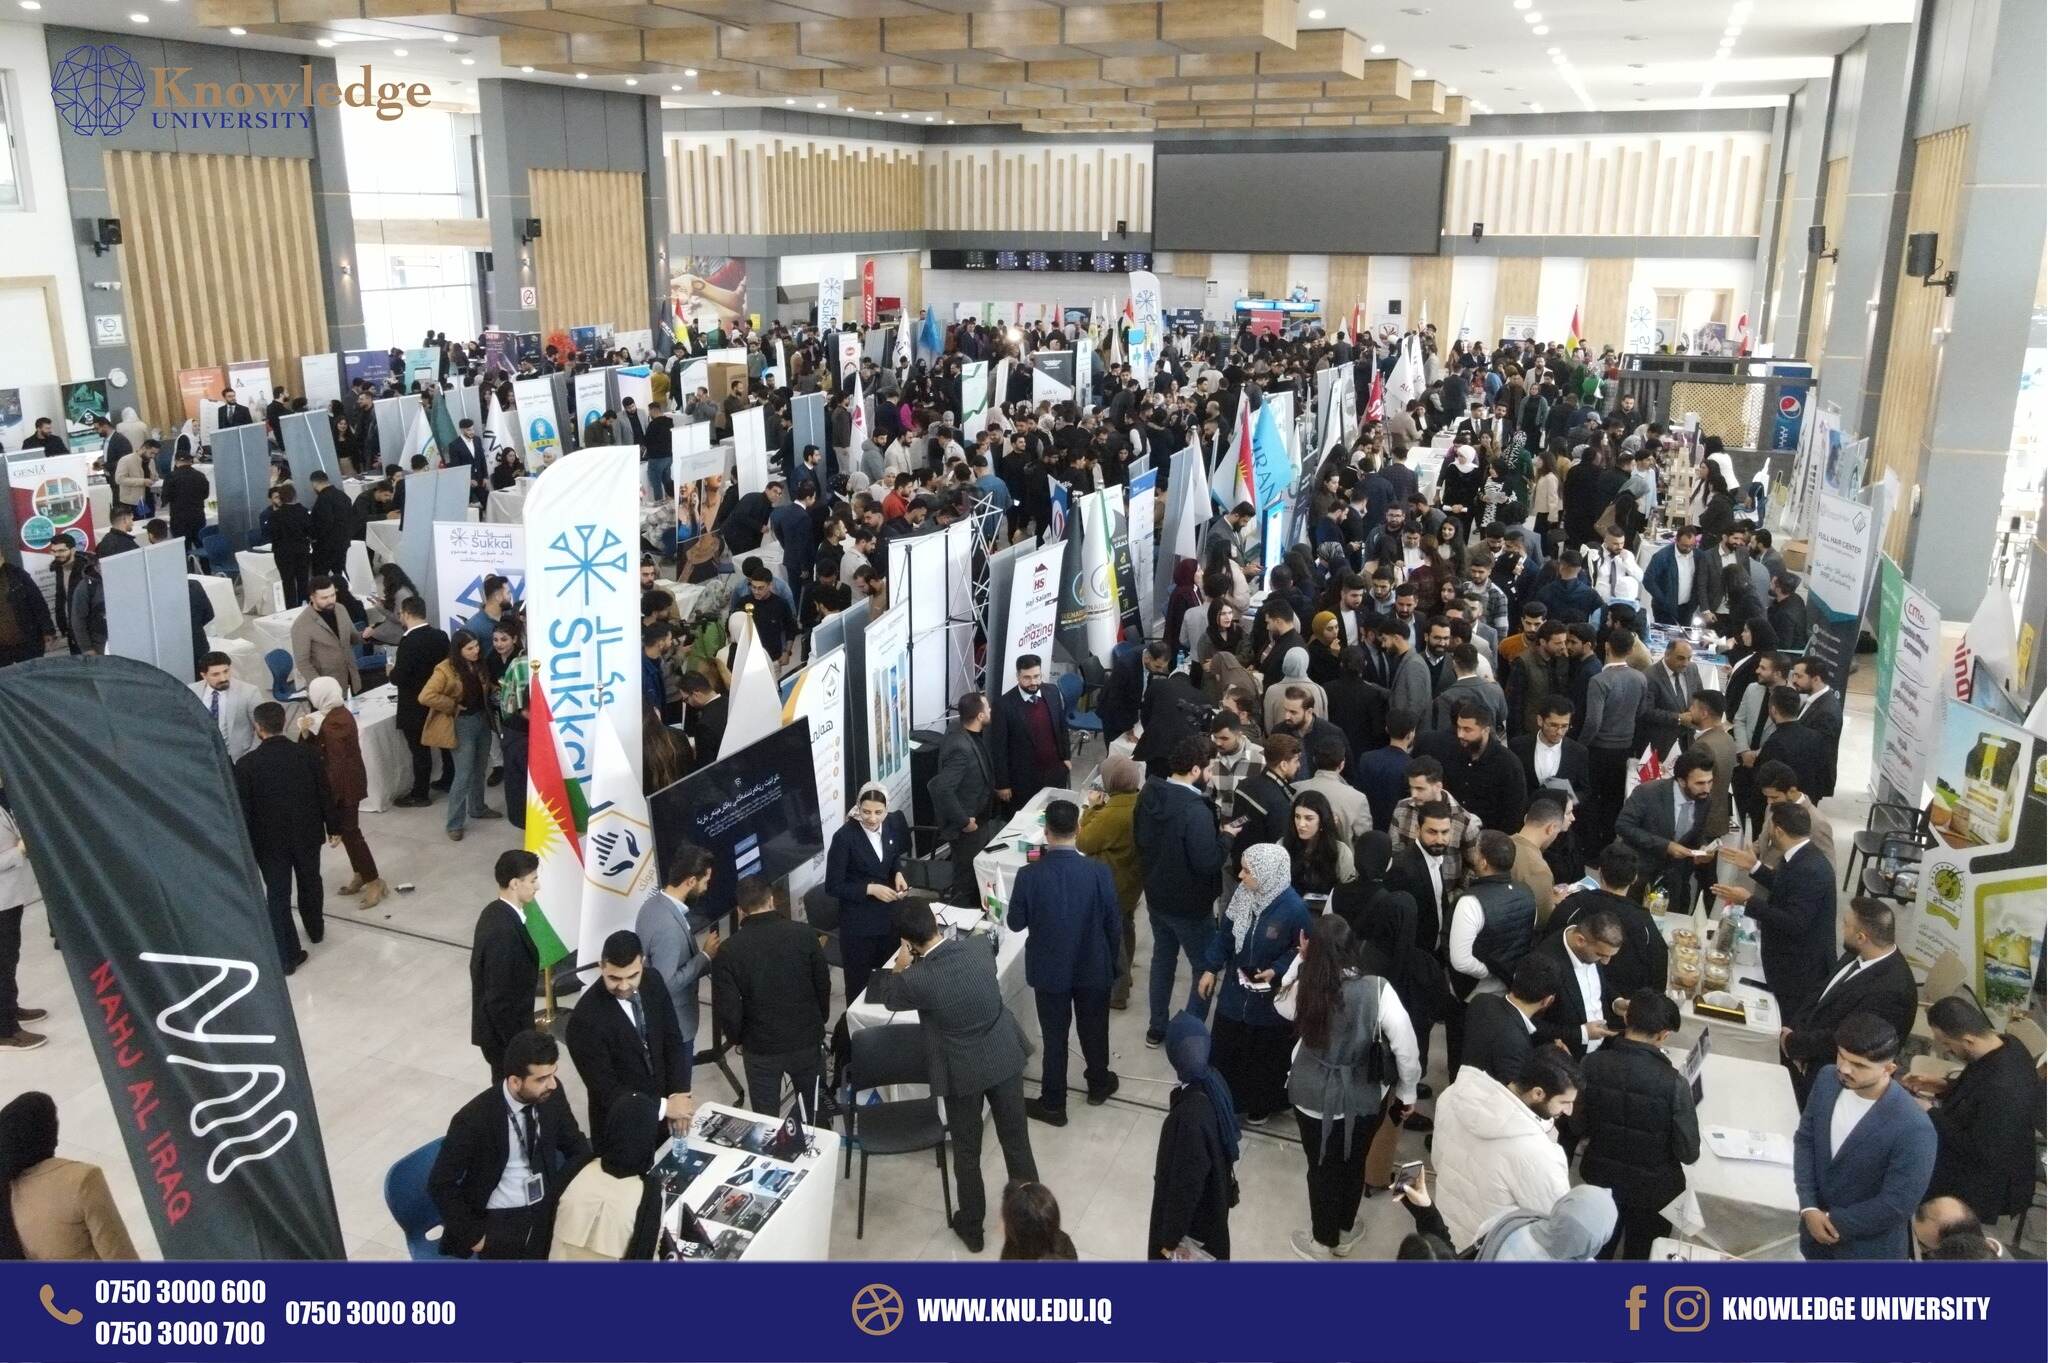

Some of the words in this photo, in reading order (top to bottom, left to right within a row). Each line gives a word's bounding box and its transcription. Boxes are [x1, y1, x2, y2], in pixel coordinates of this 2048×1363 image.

[472, 538, 513, 549] Sukkal
[1033, 578, 1046, 591] HS
[1018, 622, 1054, 648] amazing
[1030, 636, 1048, 650] team
[90, 960, 144, 1068] NAHJ
[128, 1080, 160, 1131] AL
[147, 1130, 193, 1227] IRAQ
